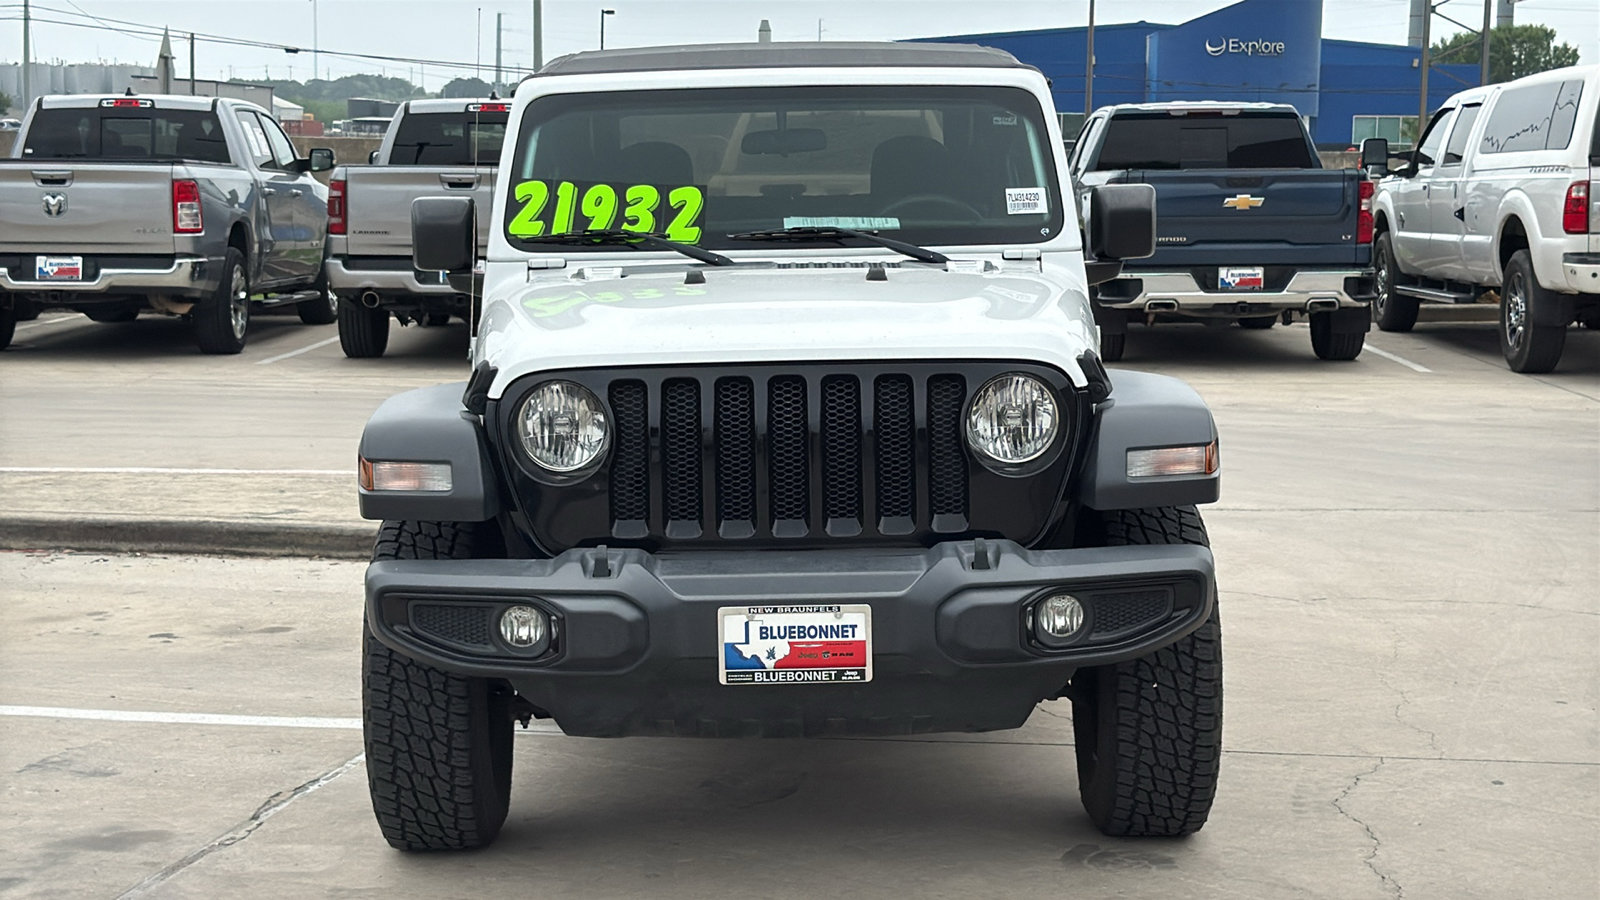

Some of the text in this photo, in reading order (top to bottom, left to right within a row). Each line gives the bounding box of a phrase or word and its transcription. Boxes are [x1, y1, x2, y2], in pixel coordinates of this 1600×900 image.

[1229, 37, 1285, 56] Explore
[508, 180, 704, 245] 21932
[777, 606, 839, 614] BRAUNFELS
[759, 624, 858, 640] BLUEBONNET
[754, 670, 837, 682] BLUEBONNET
